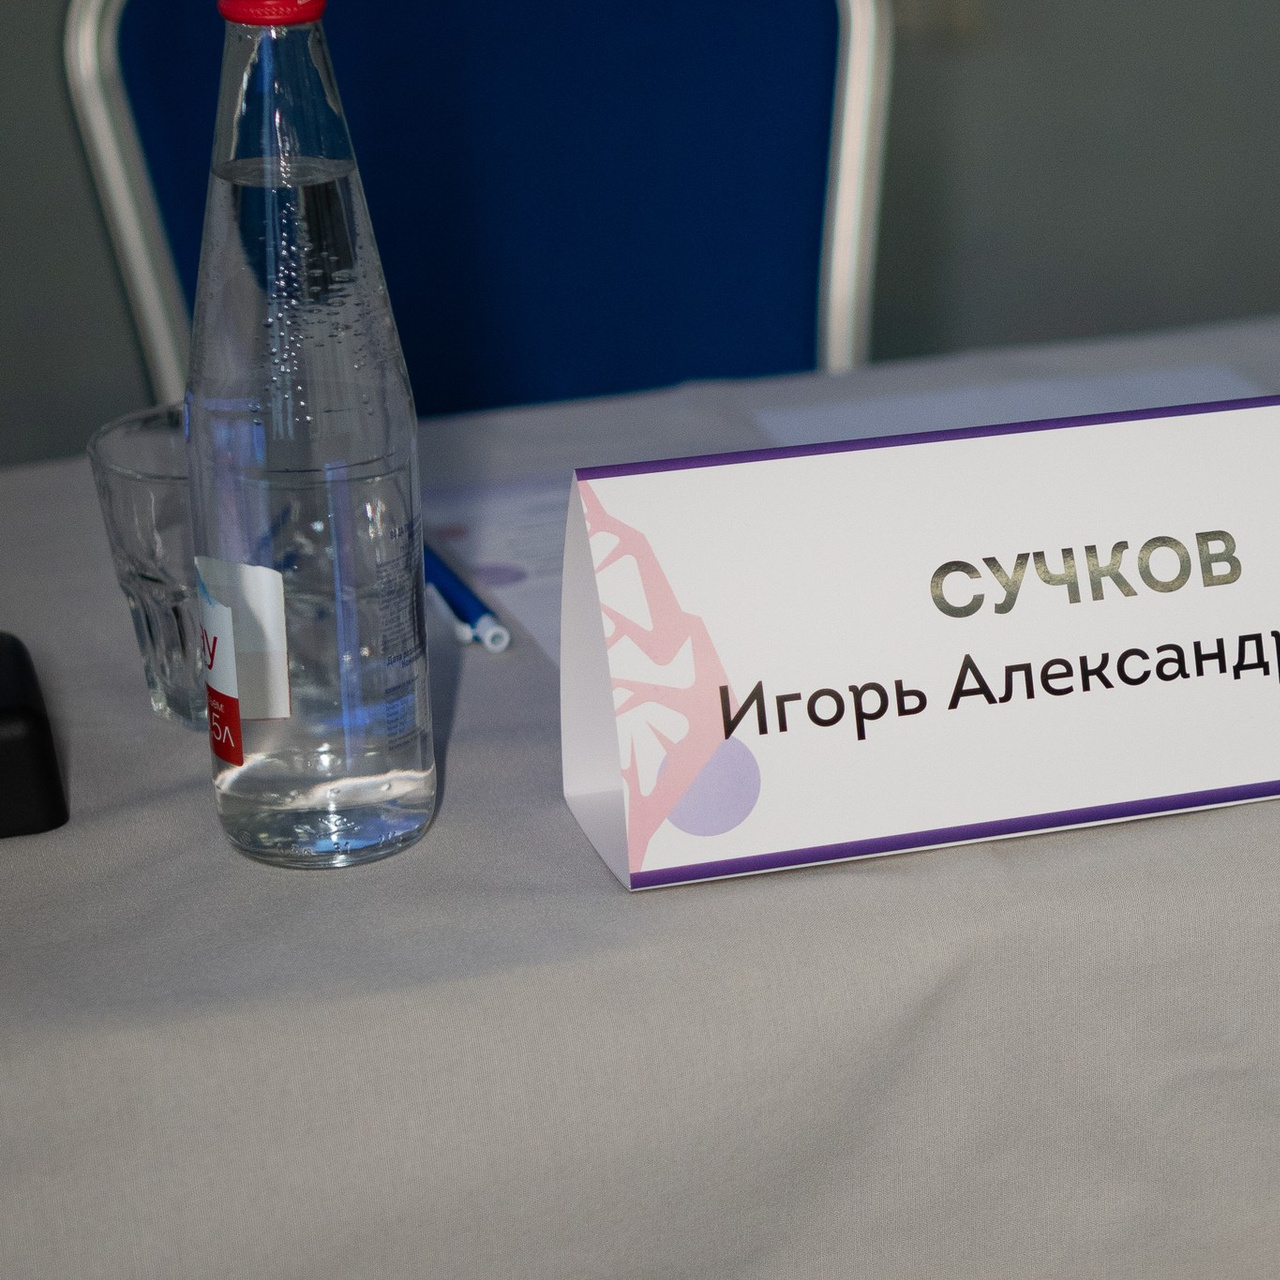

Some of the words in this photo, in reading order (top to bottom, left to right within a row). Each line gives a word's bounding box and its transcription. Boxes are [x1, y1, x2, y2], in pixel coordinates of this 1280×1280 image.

[930, 529, 1242, 619] СУЧКОВ
[211, 712, 235, 748] 5л
[718, 679, 928, 742] Игорь
